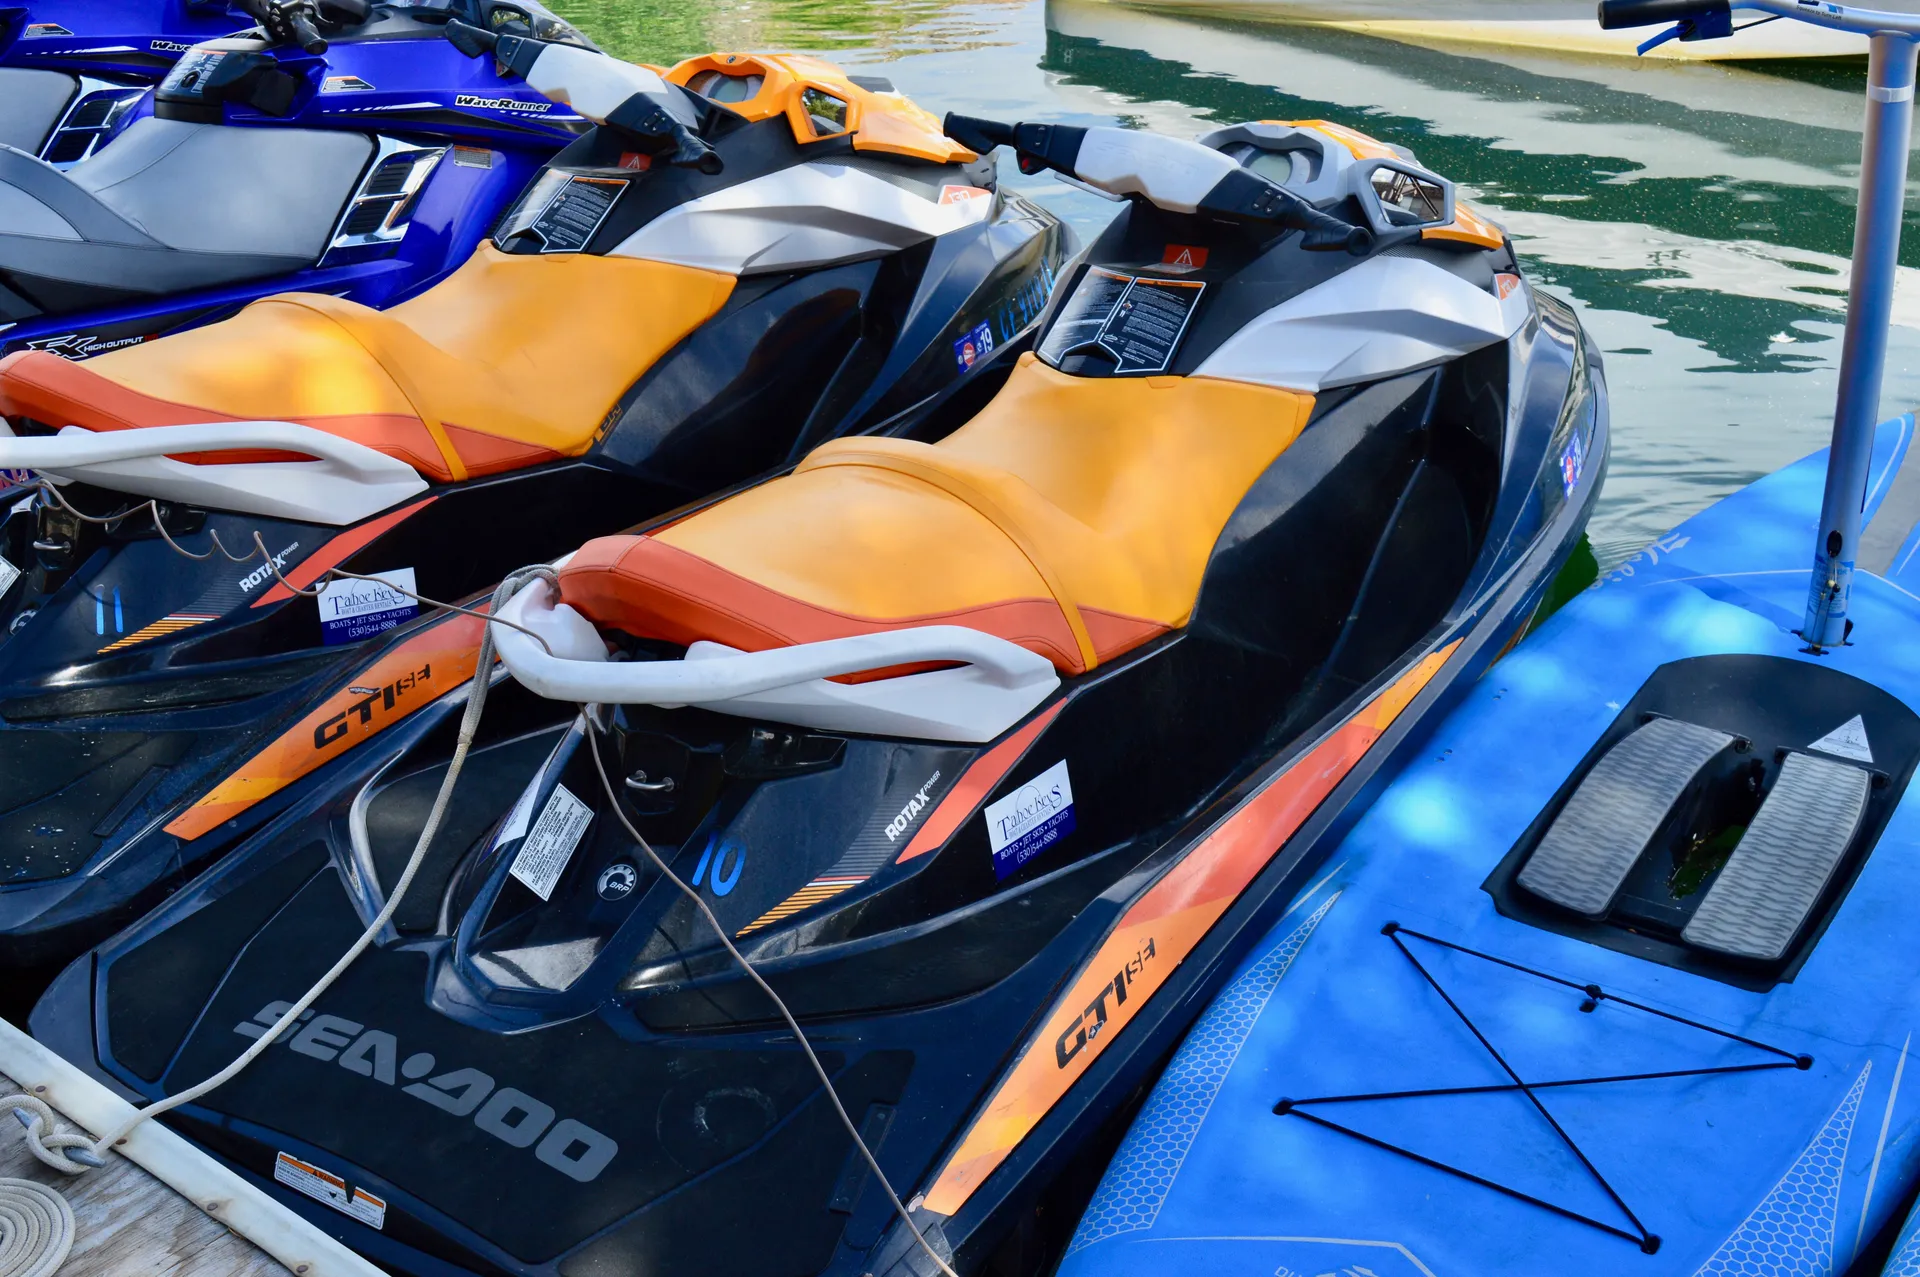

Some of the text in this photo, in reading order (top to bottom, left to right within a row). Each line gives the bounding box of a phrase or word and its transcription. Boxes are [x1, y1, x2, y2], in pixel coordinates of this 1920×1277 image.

[455, 95, 552, 112] WaveRunner
[84, 342, 105, 352] HIGH
[106, 336, 144, 349] OUTPUT
[981, 327, 993, 353] 19
[239, 542, 299, 592] ROTAX POWER
[94, 584, 124, 635] 11
[328, 591, 370, 615] Tahoe
[330, 608, 412, 629] BOATS JET SKIS YACHTS
[348, 620, 396, 638] (530)544-8888
[314, 684, 395, 750] GTI
[884, 770, 940, 842] ROTAX POWER
[997, 804, 1033, 841] Tahoe
[1000, 810, 1068, 860] BOATS JET SKIS YACHTS
[1016, 828, 1058, 864] (530)544-8888
[692, 833, 747, 896] 10
[609, 881, 630, 892] BRP
[1056, 970, 1127, 1070] GTI
